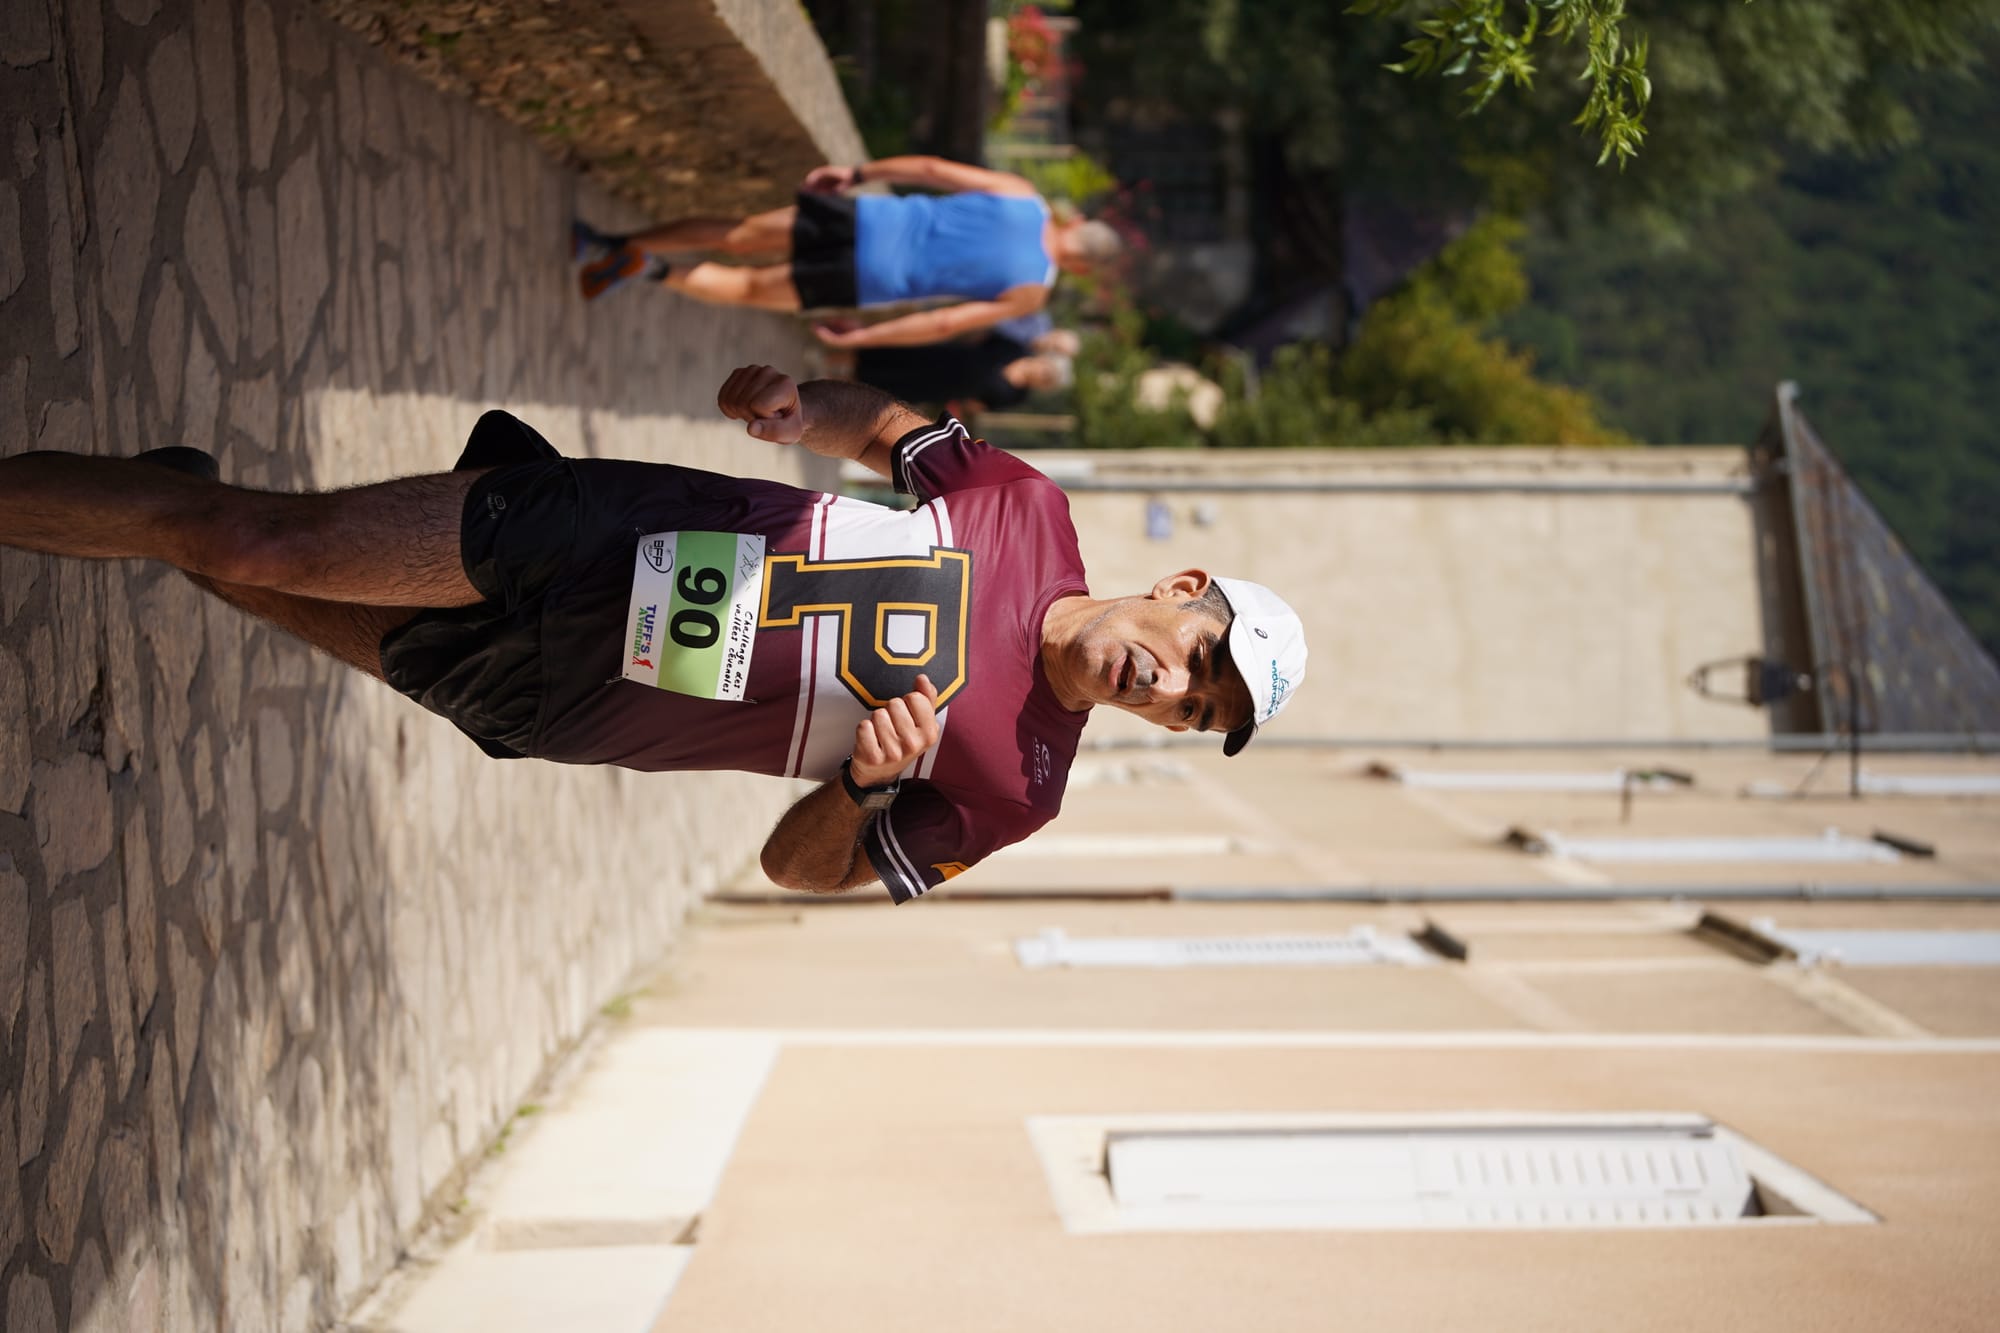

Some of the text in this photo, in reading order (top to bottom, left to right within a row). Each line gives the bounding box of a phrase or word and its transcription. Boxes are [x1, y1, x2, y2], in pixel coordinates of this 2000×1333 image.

[653, 540, 664, 567] BFP
[634, 606, 649, 657] Aventure
[640, 604, 657, 654] TUFF'S
[670, 565, 727, 649] 90
[731, 604, 742, 642] vallées
[757, 545, 974, 712] P
[734, 611, 753, 689] Challenge des
